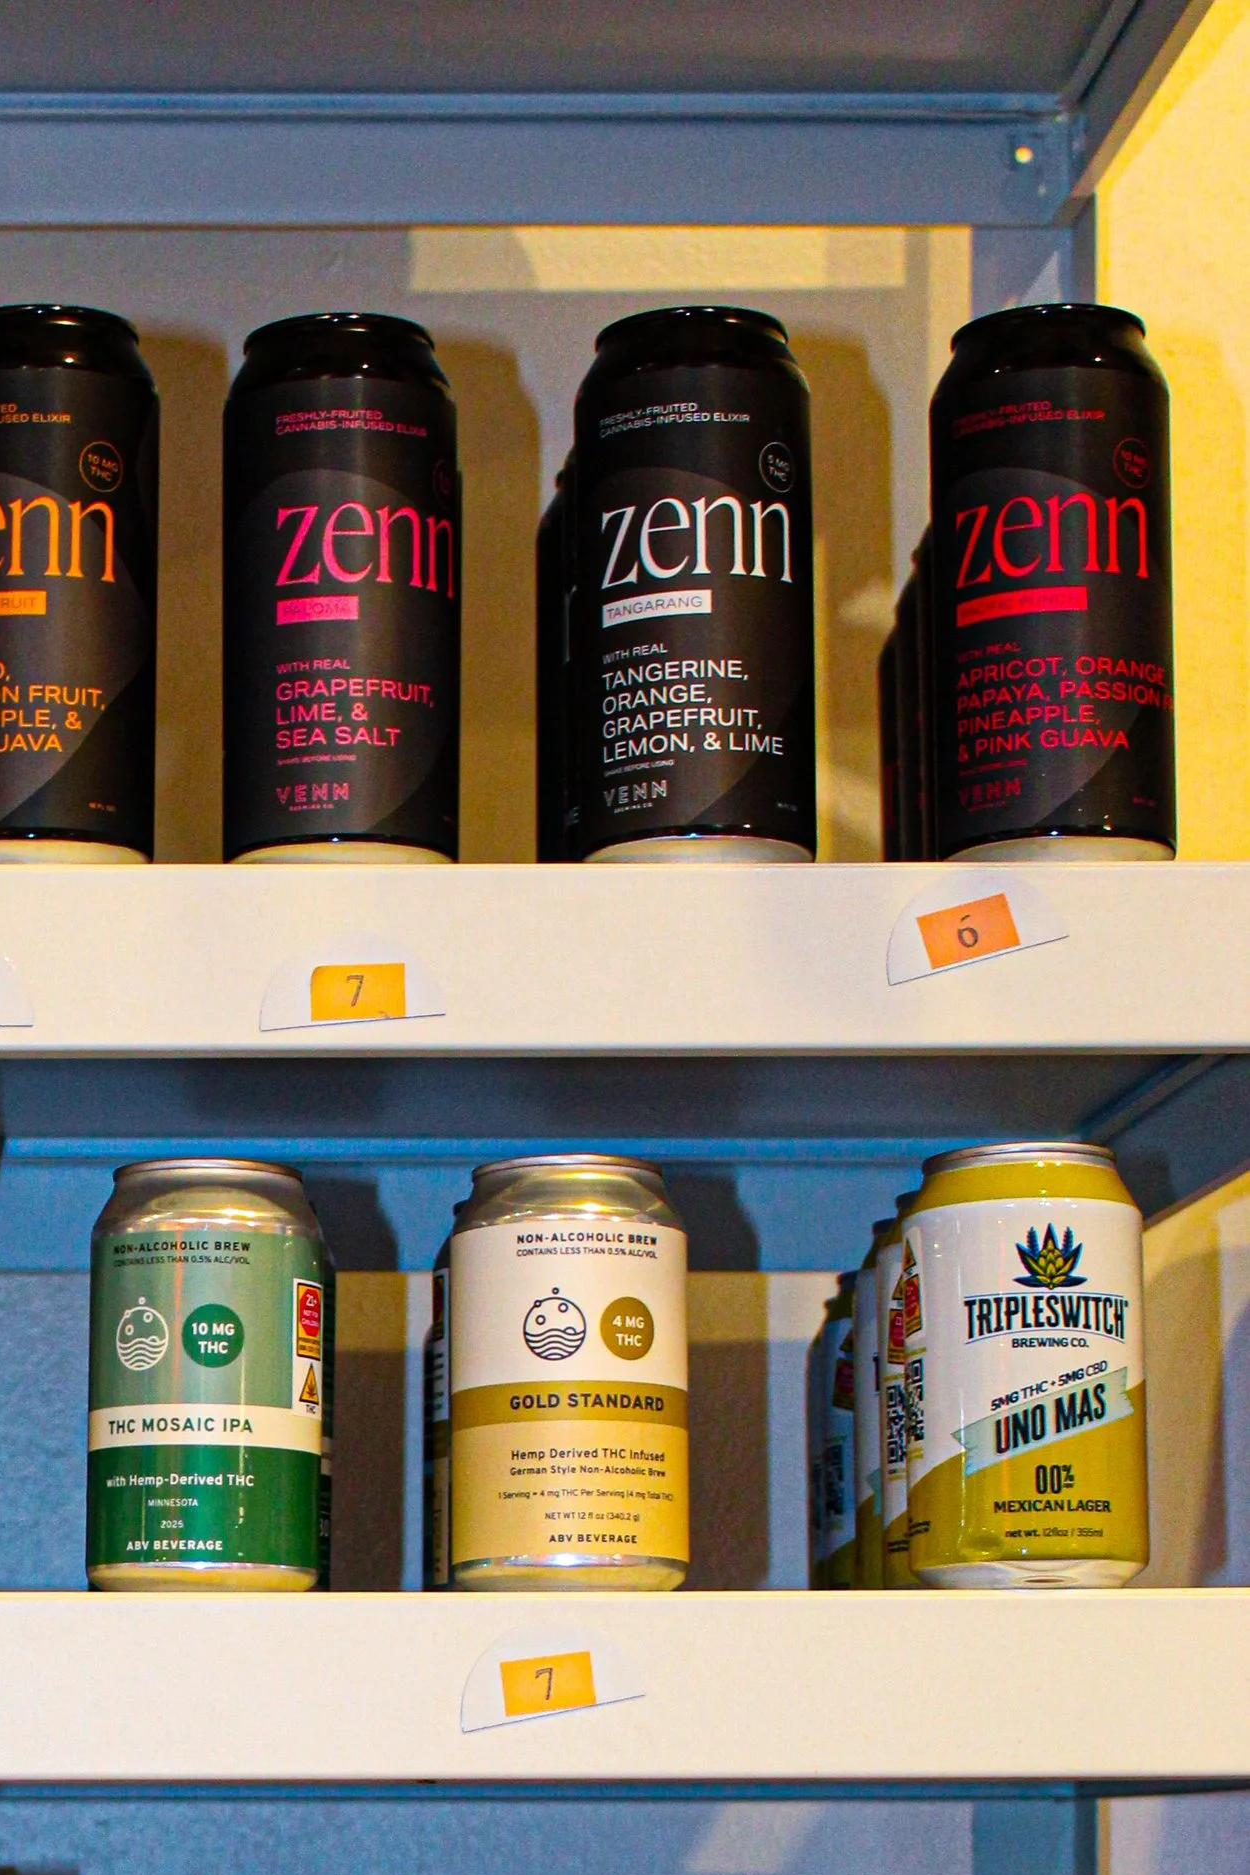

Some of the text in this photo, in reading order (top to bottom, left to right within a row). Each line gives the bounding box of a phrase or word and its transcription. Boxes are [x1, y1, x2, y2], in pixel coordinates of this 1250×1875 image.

[275, 500, 453, 598] zenn
[601, 495, 793, 590] zenn
[956, 492, 1148, 589] zenn
[602, 659, 749, 690] TANGERINE,
[29, 685, 105, 711] FRUIT,
[65, 711, 82, 729] &
[276, 702, 368, 725] LIME, &
[957, 705, 1101, 738] PINEAPPLE,
[275, 727, 400, 749] SEA SALT
[603, 732, 784, 763] LEMON, & LIME
[975, 733, 1031, 760] PINK
[1040, 729, 1129, 750] GUAVA
[958, 914, 980, 950] 6
[346, 974, 365, 1009] 7
[191, 1322, 235, 1336] 10 MG
[612, 1315, 645, 1329] 4 MG
[198, 1341, 228, 1355] THC
[616, 1334, 642, 1347] THC
[510, 1393, 664, 1411] GOLD STANDARD
[109, 1418, 252, 1435] THC MOSAIC IPA
[995, 1383, 1106, 1455] UNO MAS
[994, 1500, 1111, 1513] MEXICAN LAGER
[535, 1667, 553, 1700] 7
